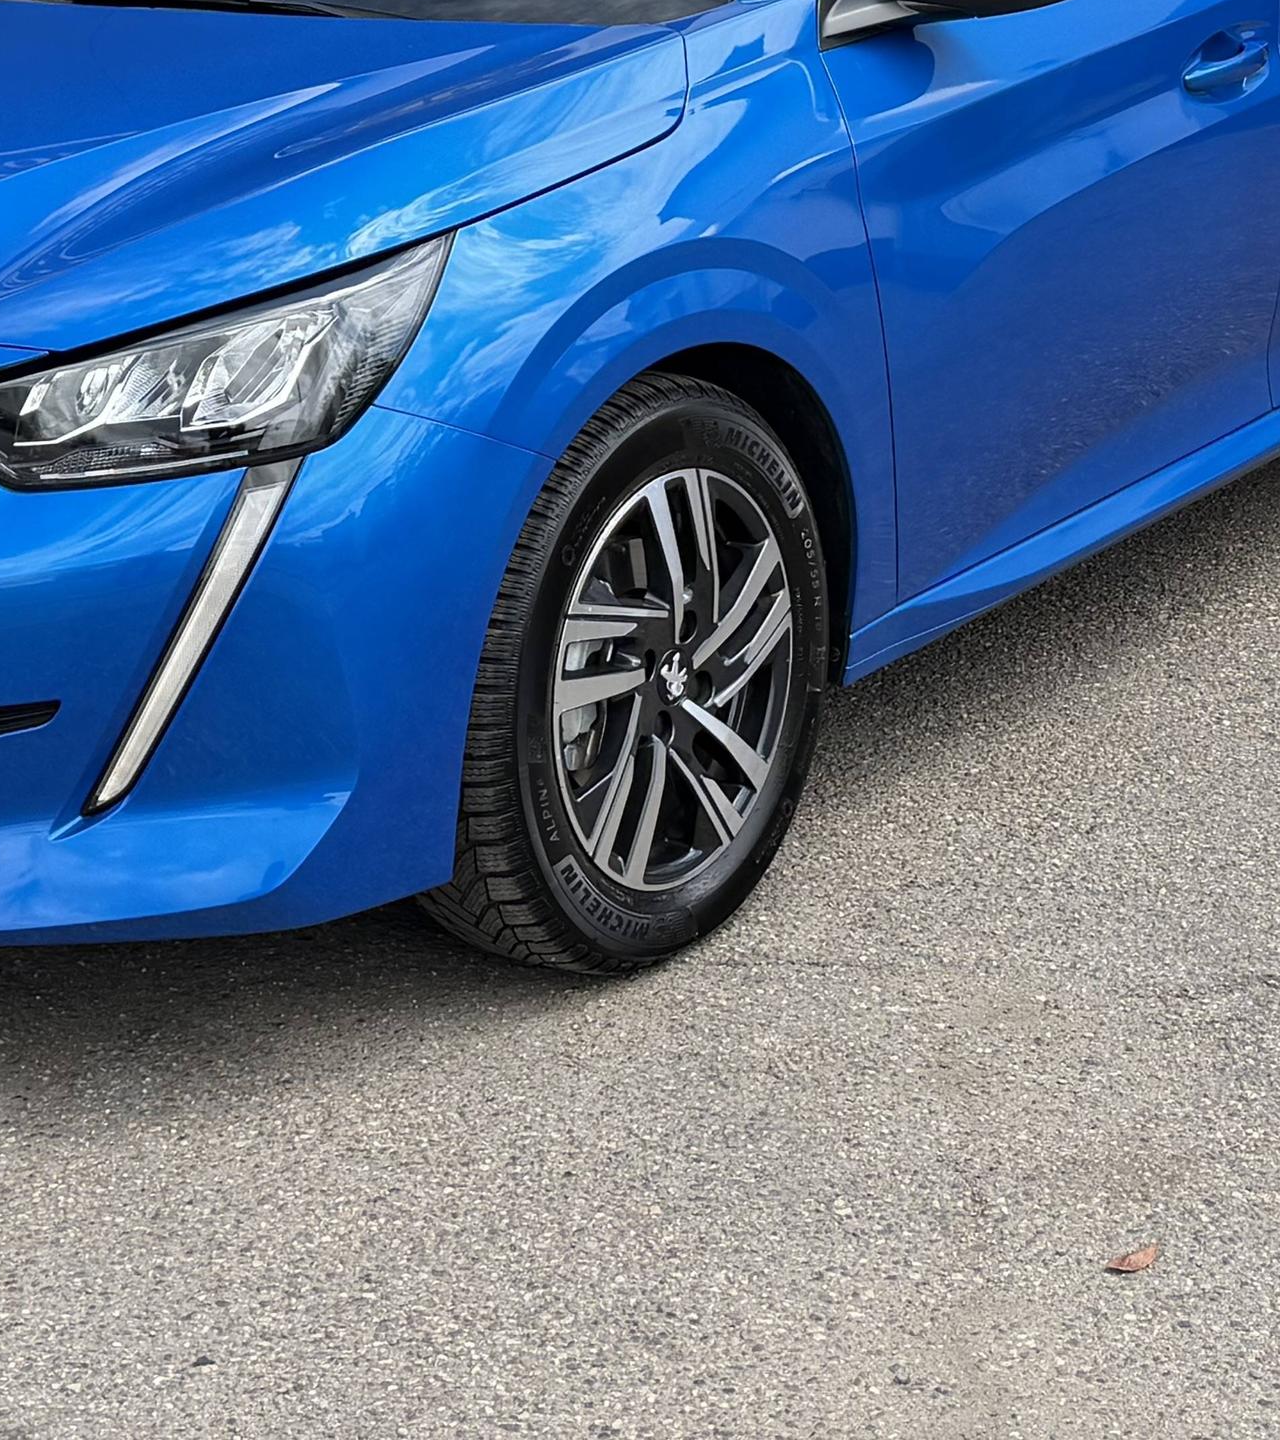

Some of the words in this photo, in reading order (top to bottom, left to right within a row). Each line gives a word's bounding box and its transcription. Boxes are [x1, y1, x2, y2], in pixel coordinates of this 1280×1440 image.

[724, 426, 803, 510] MICHELIN
[537, 788, 560, 842] ALPIN
[561, 863, 651, 941] MICHELIN
